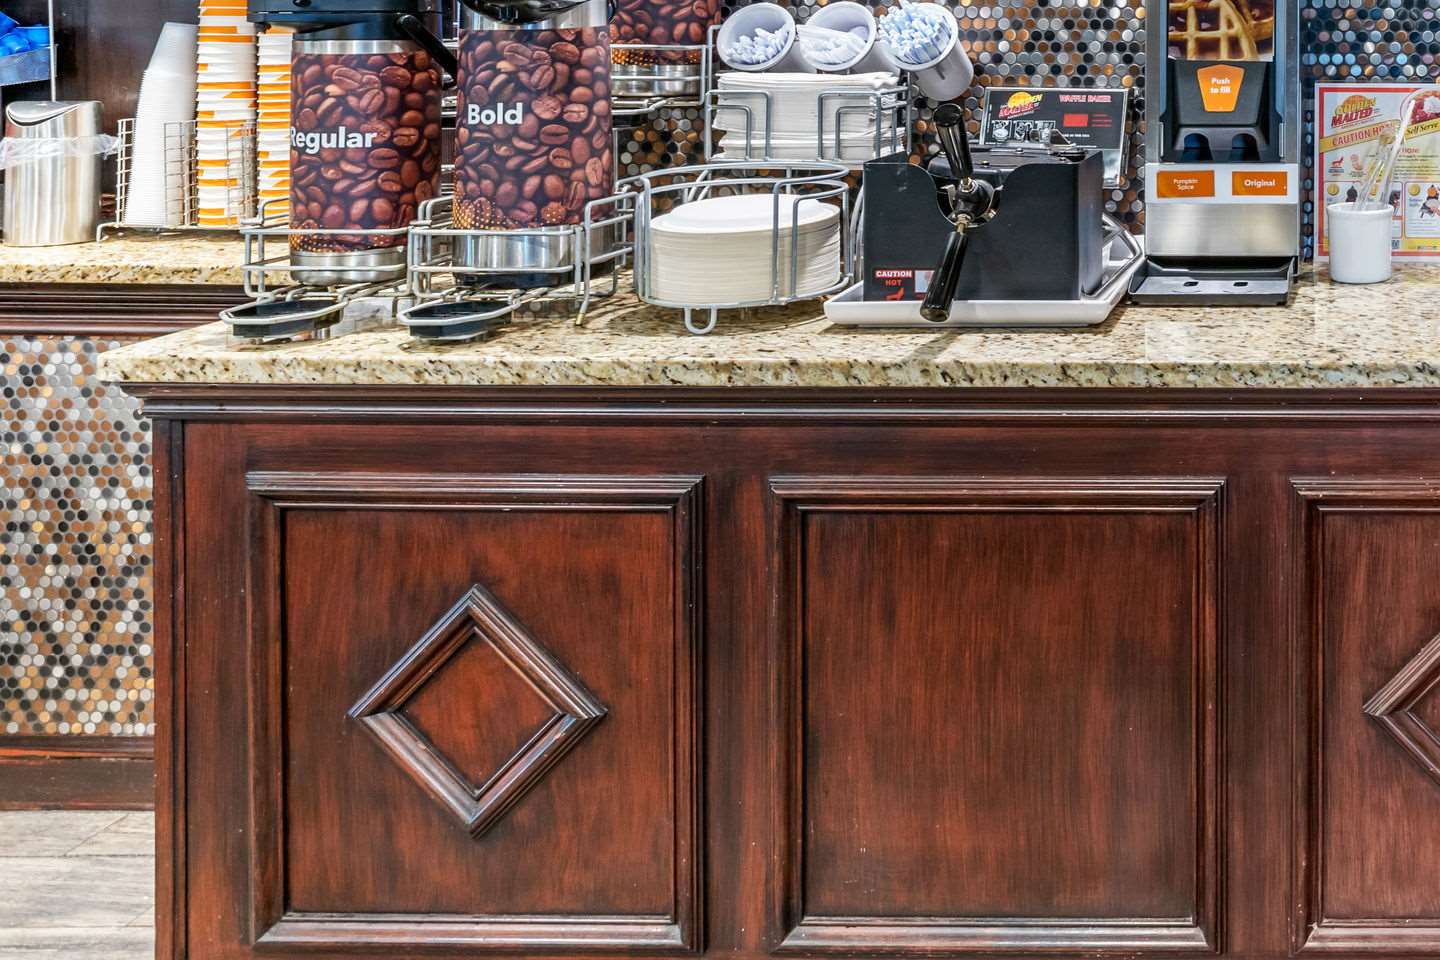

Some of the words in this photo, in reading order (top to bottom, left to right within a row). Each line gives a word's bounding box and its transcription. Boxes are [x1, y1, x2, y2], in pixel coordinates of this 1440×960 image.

[1211, 77, 1231, 85] Push
[467, 102, 523, 125] Bold
[1331, 107, 1373, 128] MALTED
[1332, 126, 1370, 146] CAUTION
[1406, 126, 1418, 136] Self
[1420, 122, 1439, 133] Serve
[291, 126, 378, 155] Regular
[1244, 179, 1275, 189] Original
[875, 270, 912, 278] CAUTION
